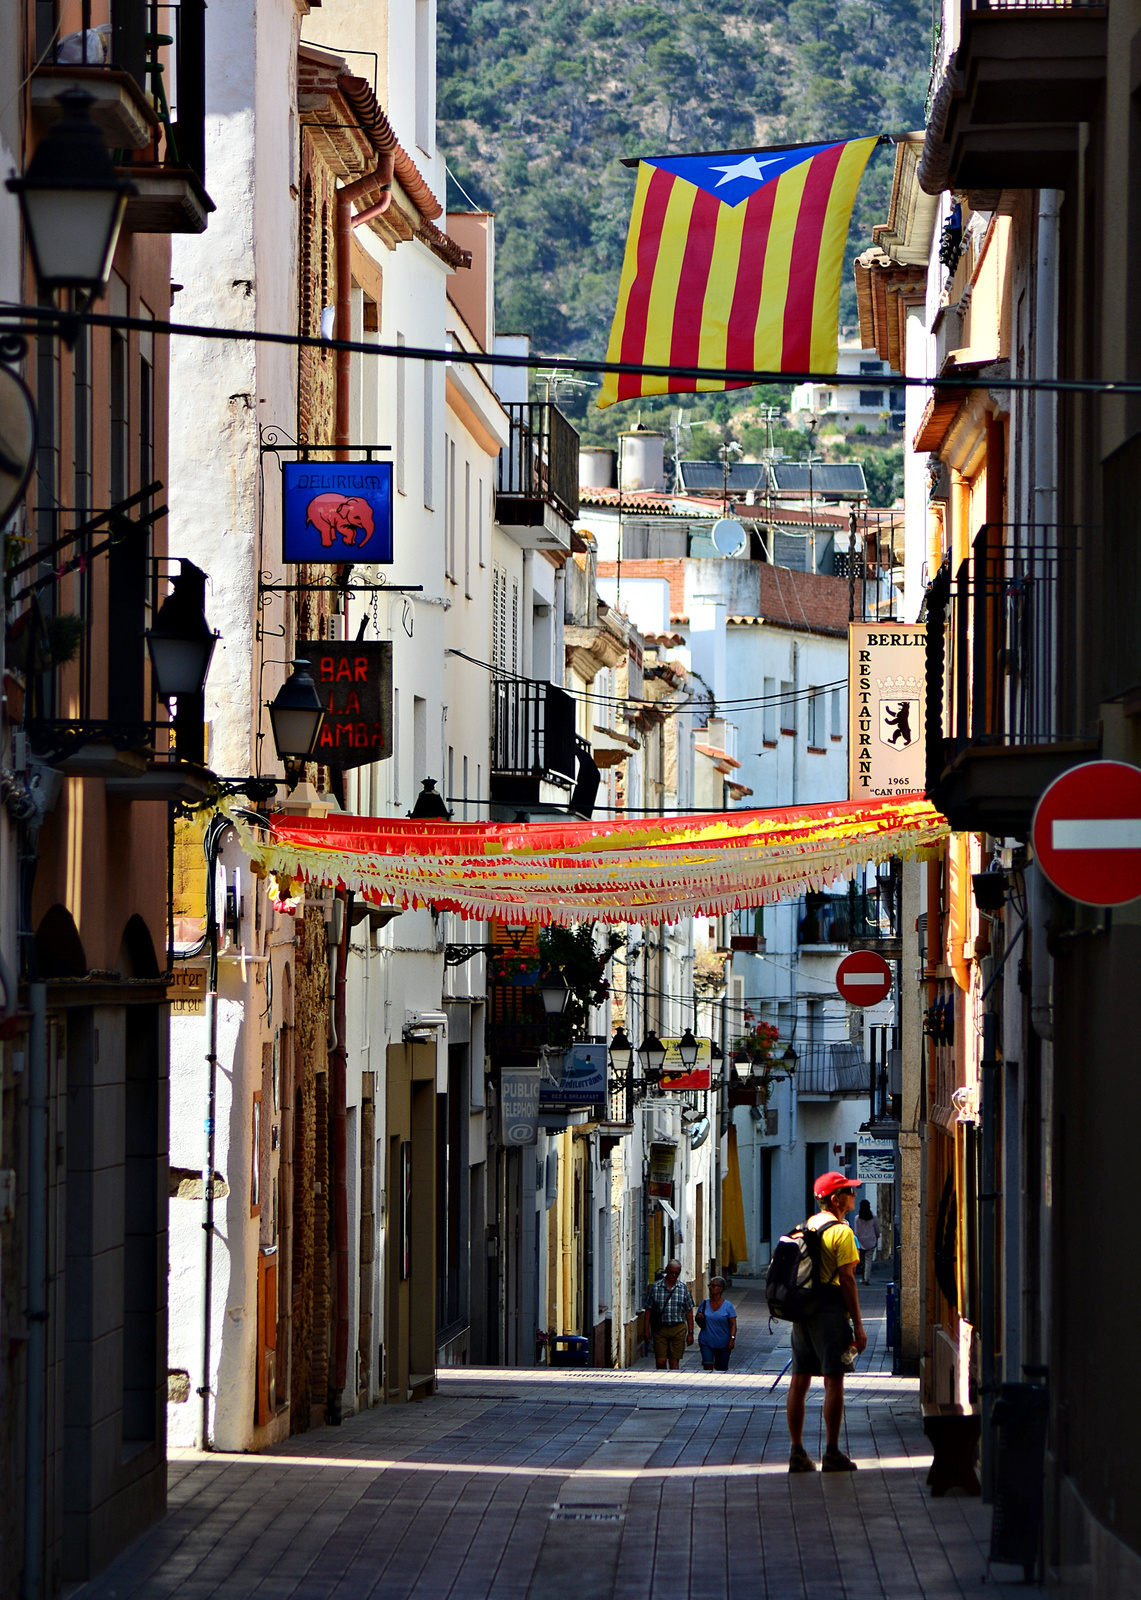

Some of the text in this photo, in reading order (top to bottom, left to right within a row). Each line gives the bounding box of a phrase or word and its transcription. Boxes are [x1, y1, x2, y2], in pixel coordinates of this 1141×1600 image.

[298, 474, 382, 490] DELIRIUM
[320, 656, 369, 682] BAR
[329, 688, 360, 715] LA
[858, 650, 872, 787] RESTAURANT
[319, 722, 385, 748] AMBA
[888, 777, 910, 785] 1965
[503, 1082, 540, 1098] PUBLIC
